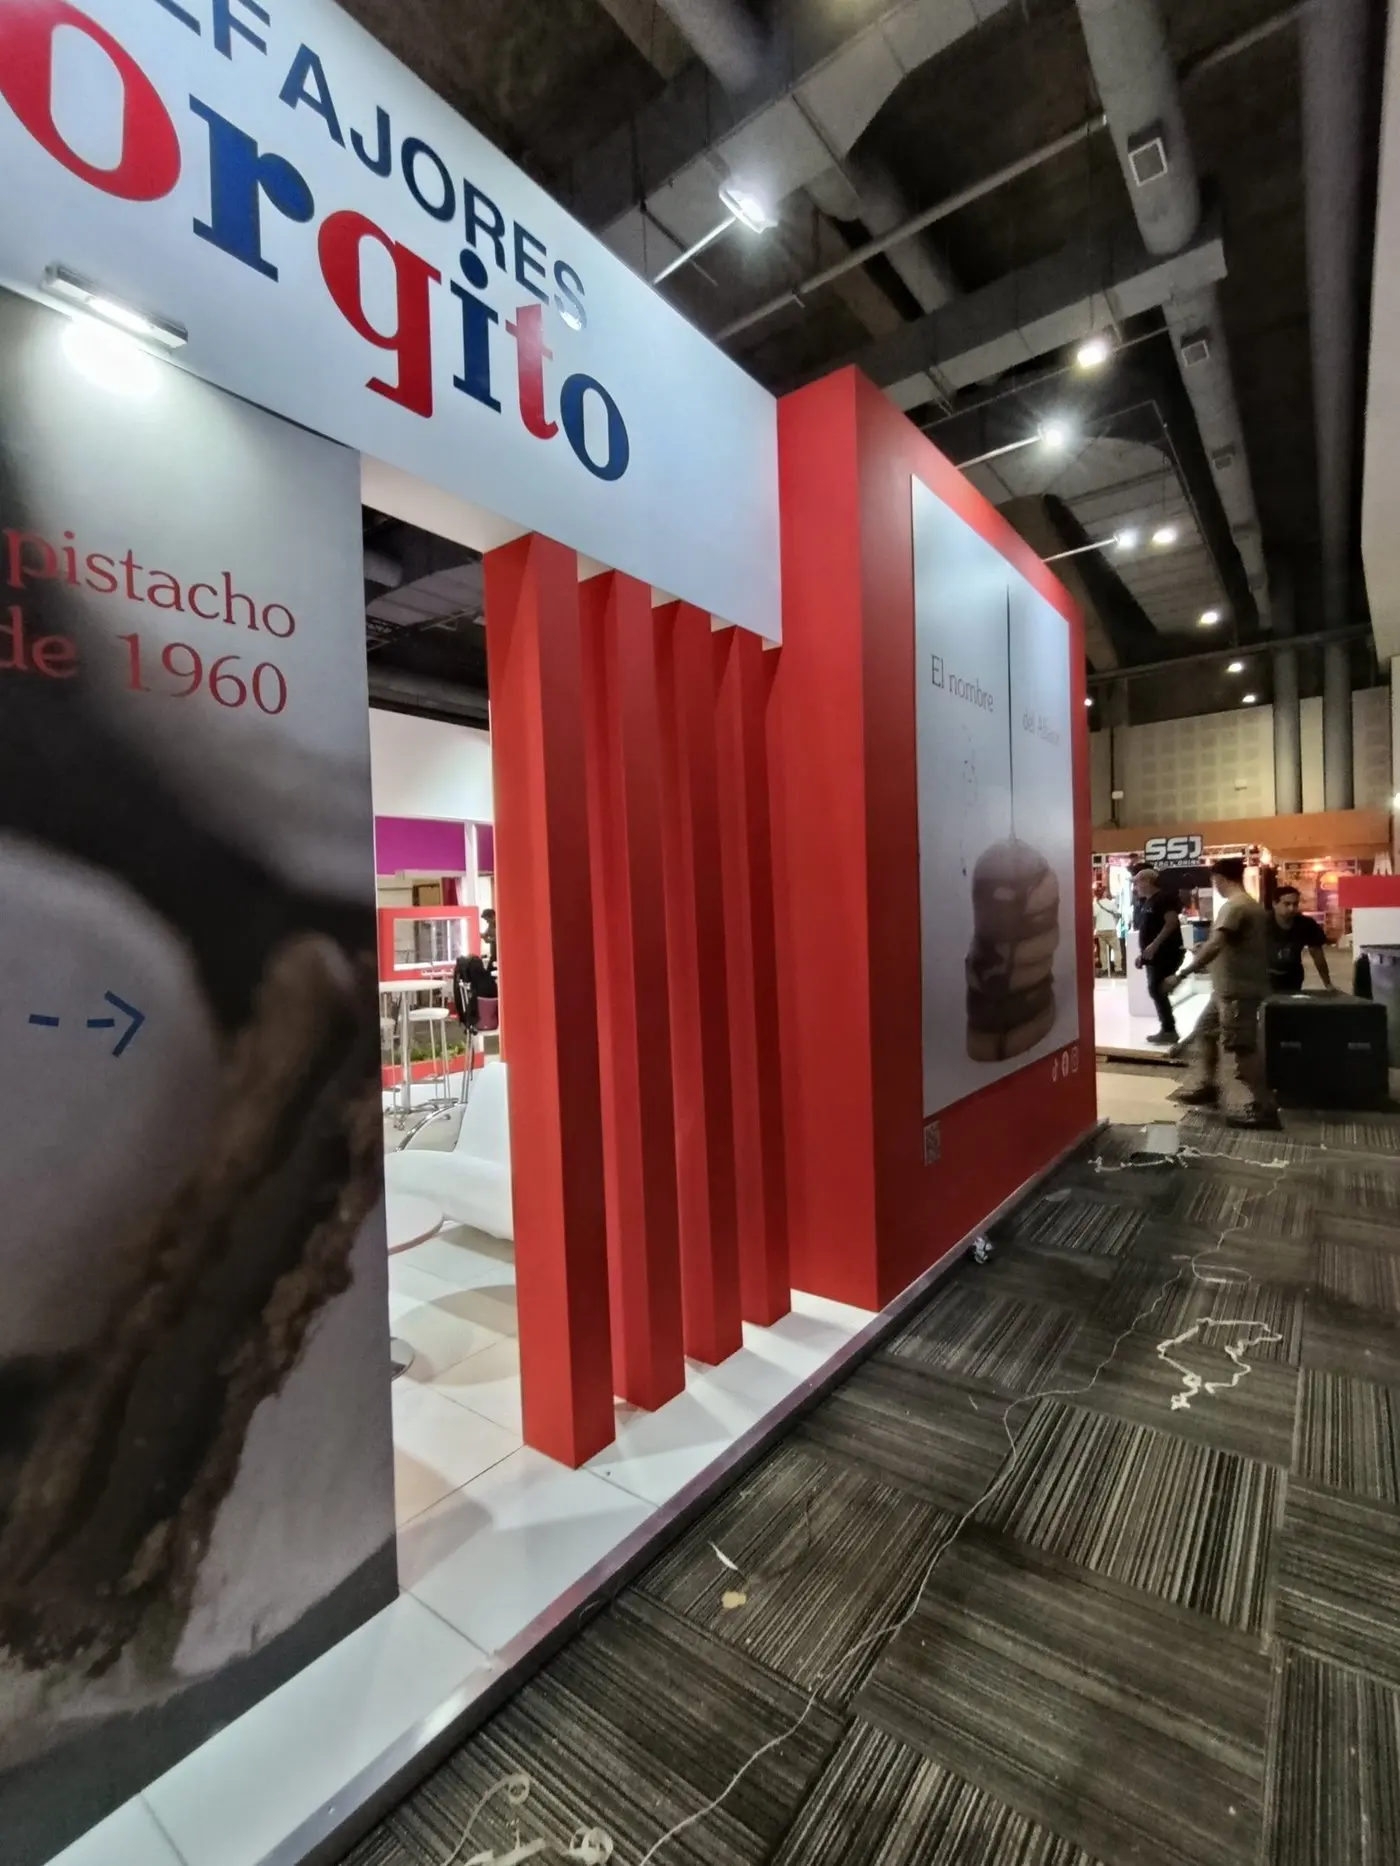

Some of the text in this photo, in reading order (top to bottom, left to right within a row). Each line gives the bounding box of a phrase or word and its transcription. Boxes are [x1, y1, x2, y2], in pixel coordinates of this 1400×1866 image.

[3, 529, 297, 638] pistacho
[117, 632, 288, 716] 1960
[931, 653, 995, 714] El nombre
[1145, 836, 1202, 860] SSJ
